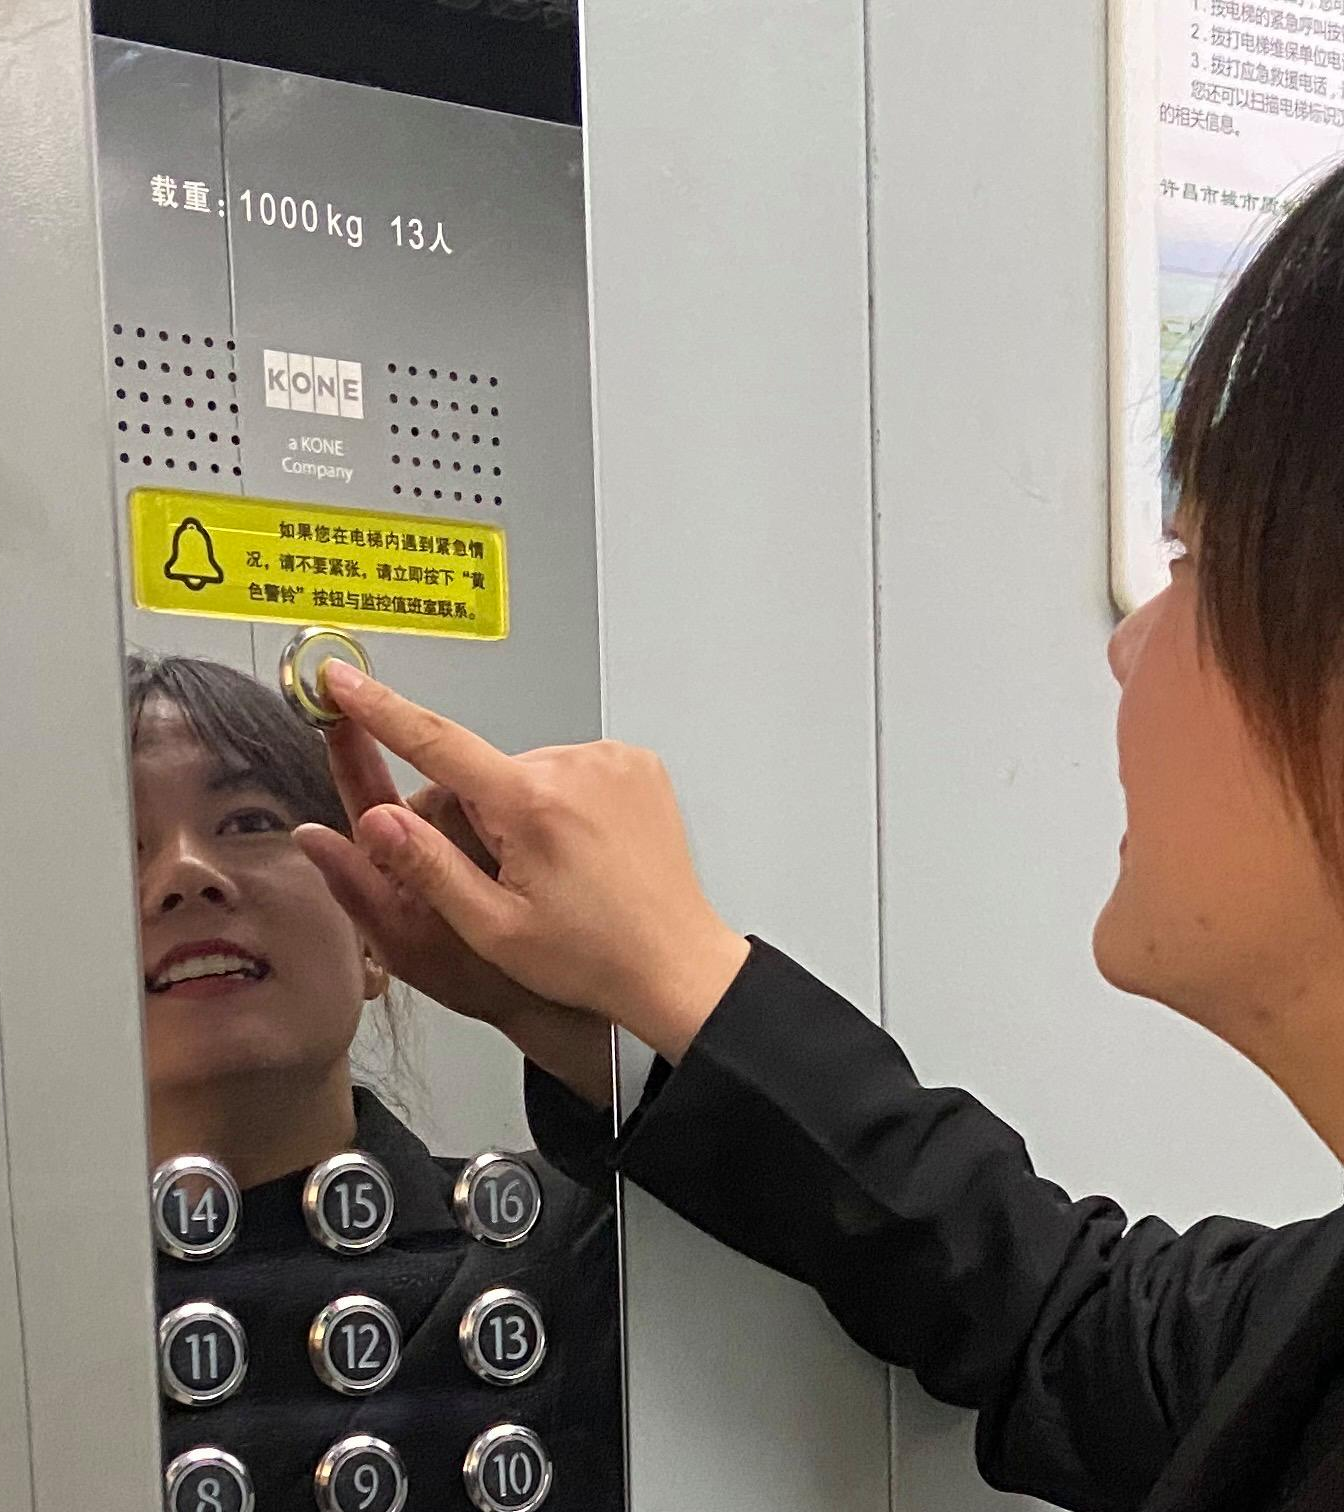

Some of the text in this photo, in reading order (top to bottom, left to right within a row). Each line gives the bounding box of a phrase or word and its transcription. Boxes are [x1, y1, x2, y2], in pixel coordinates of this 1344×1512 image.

[1159, 102, 1241, 137] 的相关信息。
[389, 215, 454, 255] 13人
[266, 364, 361, 405] KONE
[288, 436, 346, 457] a KONE
[281, 457, 354, 484] Company
[279, 520, 485, 560] 如果您在电梯内遇到紧急情
[172, 1187, 218, 1235] 14
[334, 1182, 378, 1230] 15
[483, 1178, 526, 1225] 16
[185, 1331, 218, 1381] 11
[340, 1323, 380, 1370] 12
[488, 1315, 529, 1362] 13
[353, 1463, 380, 1511] 9
[492, 1451, 534, 1498] 10
